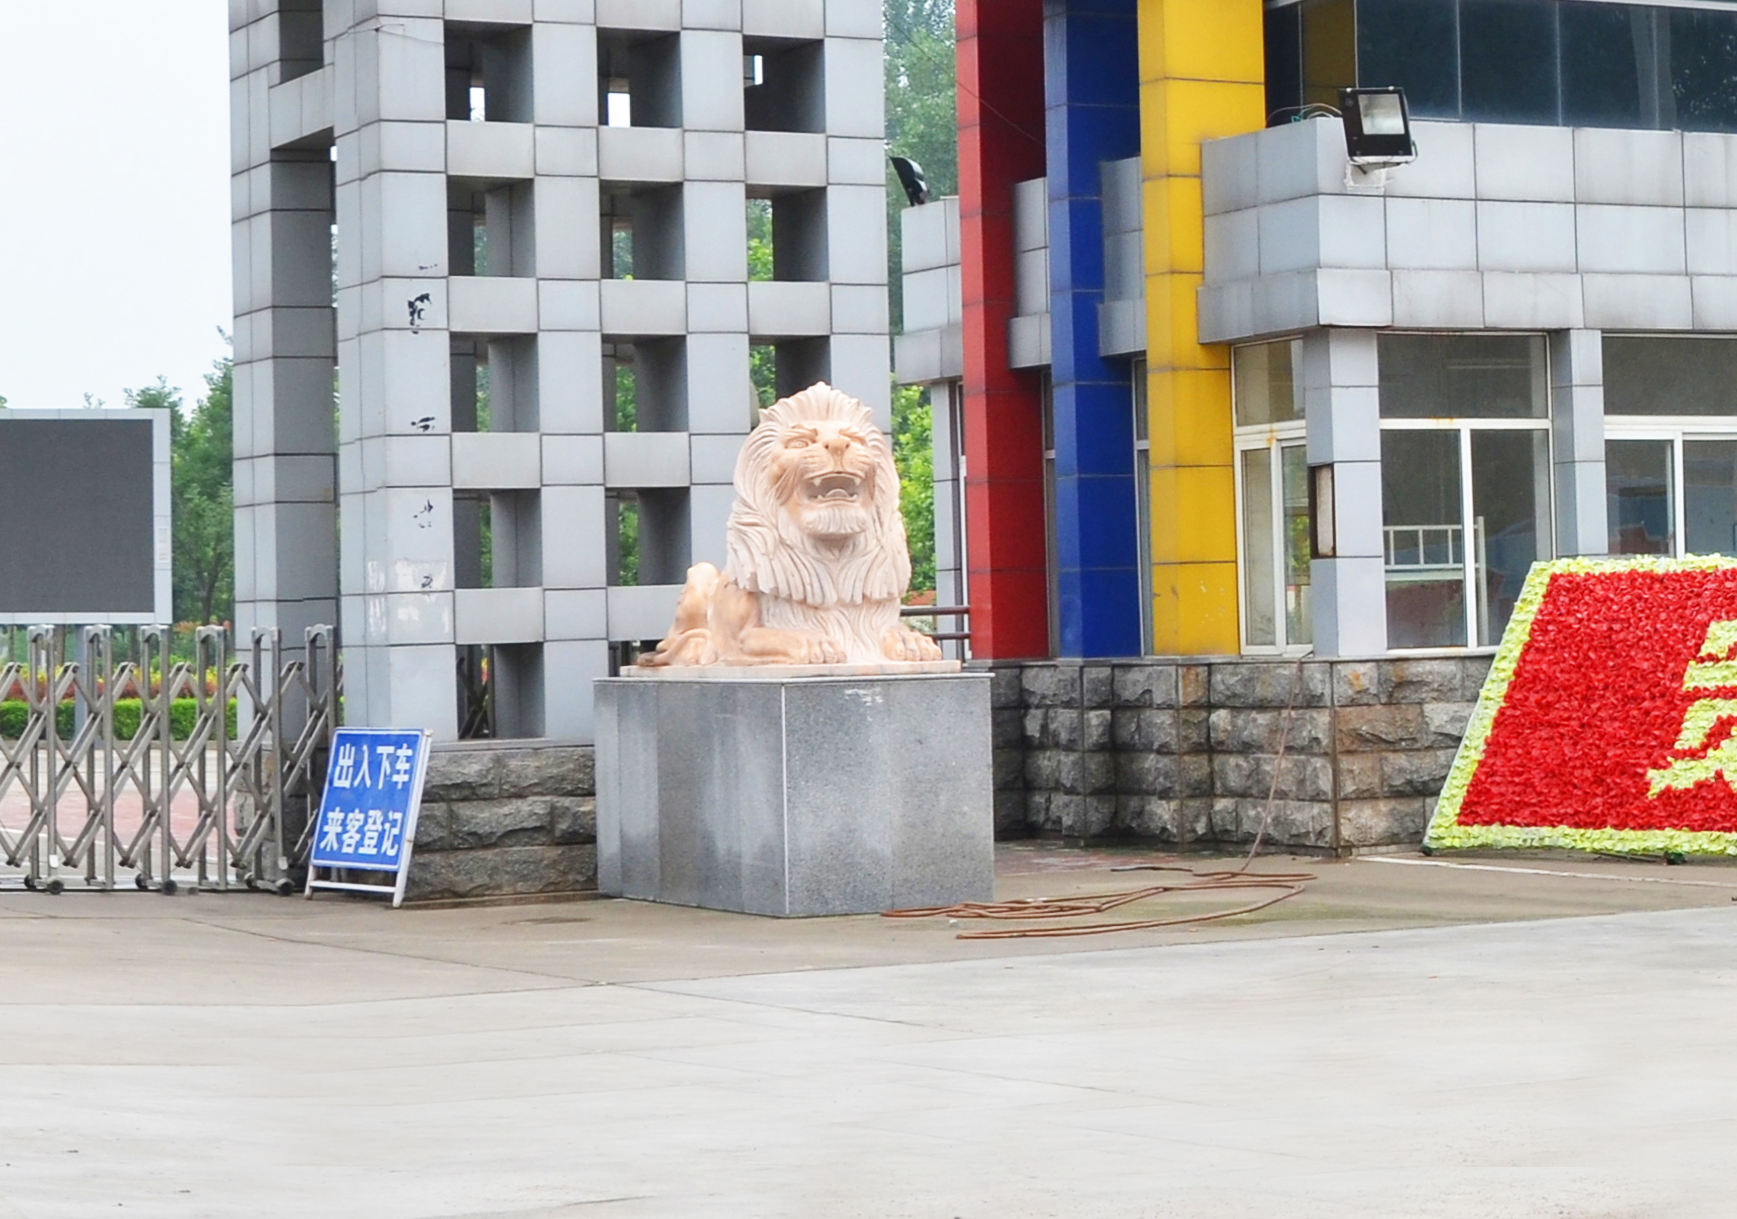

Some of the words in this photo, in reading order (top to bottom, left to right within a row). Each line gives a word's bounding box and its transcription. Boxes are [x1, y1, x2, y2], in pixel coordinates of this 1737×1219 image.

[332, 743, 414, 790] 出入下车
[319, 807, 403, 857] 来客登记
